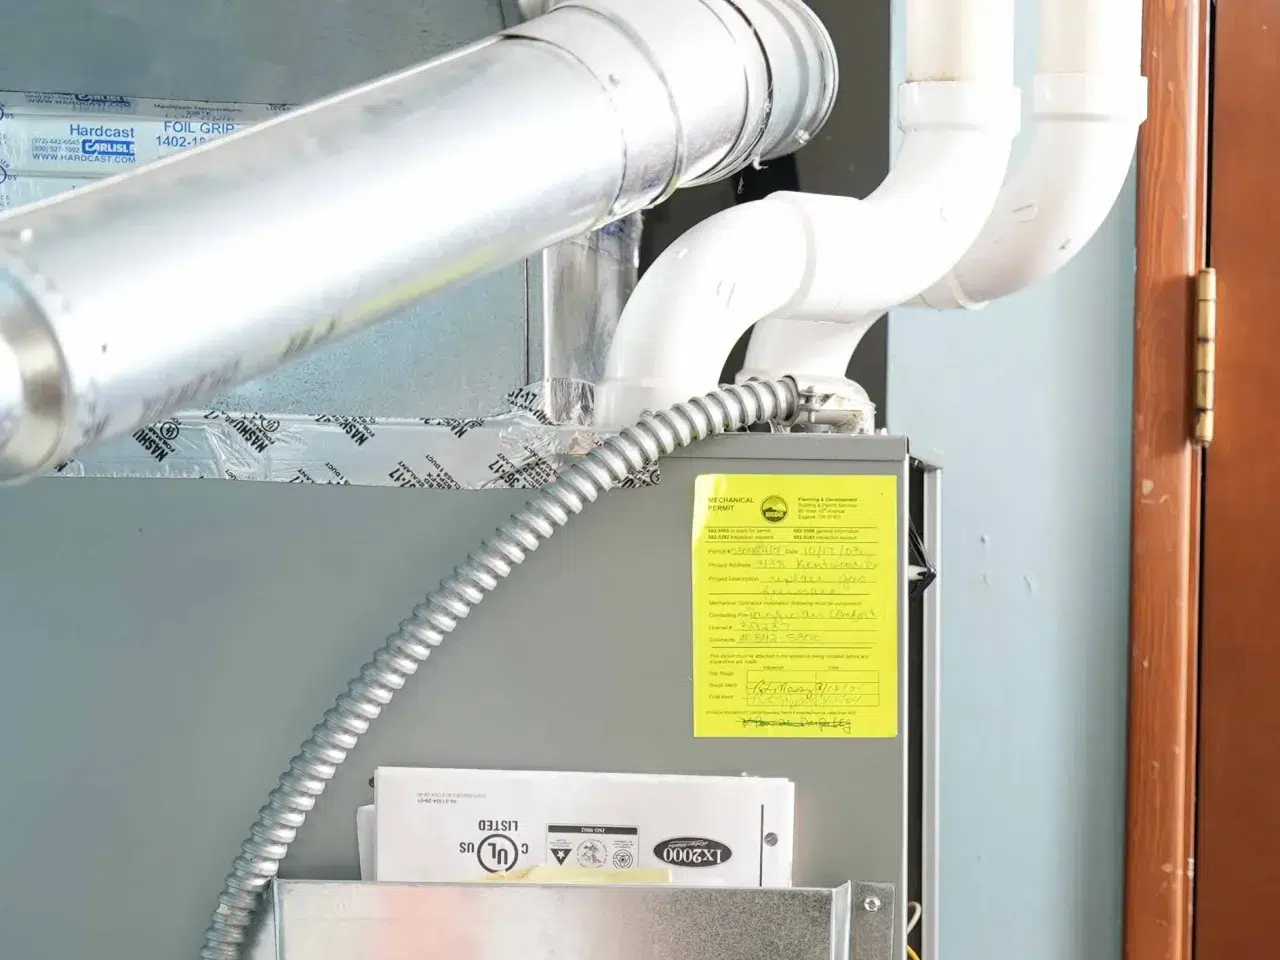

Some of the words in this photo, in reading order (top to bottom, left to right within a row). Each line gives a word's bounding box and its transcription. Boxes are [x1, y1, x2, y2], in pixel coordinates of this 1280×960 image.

[70, 124, 135, 139] Hardcast
[164, 121, 196, 133] FOIL
[200, 123, 235, 134] GRIP
[81, 139, 136, 155] CARLISLE
[132, 429, 169, 463] NASHU
[478, 820, 519, 831] LISTED
[459, 842, 475, 853] US
